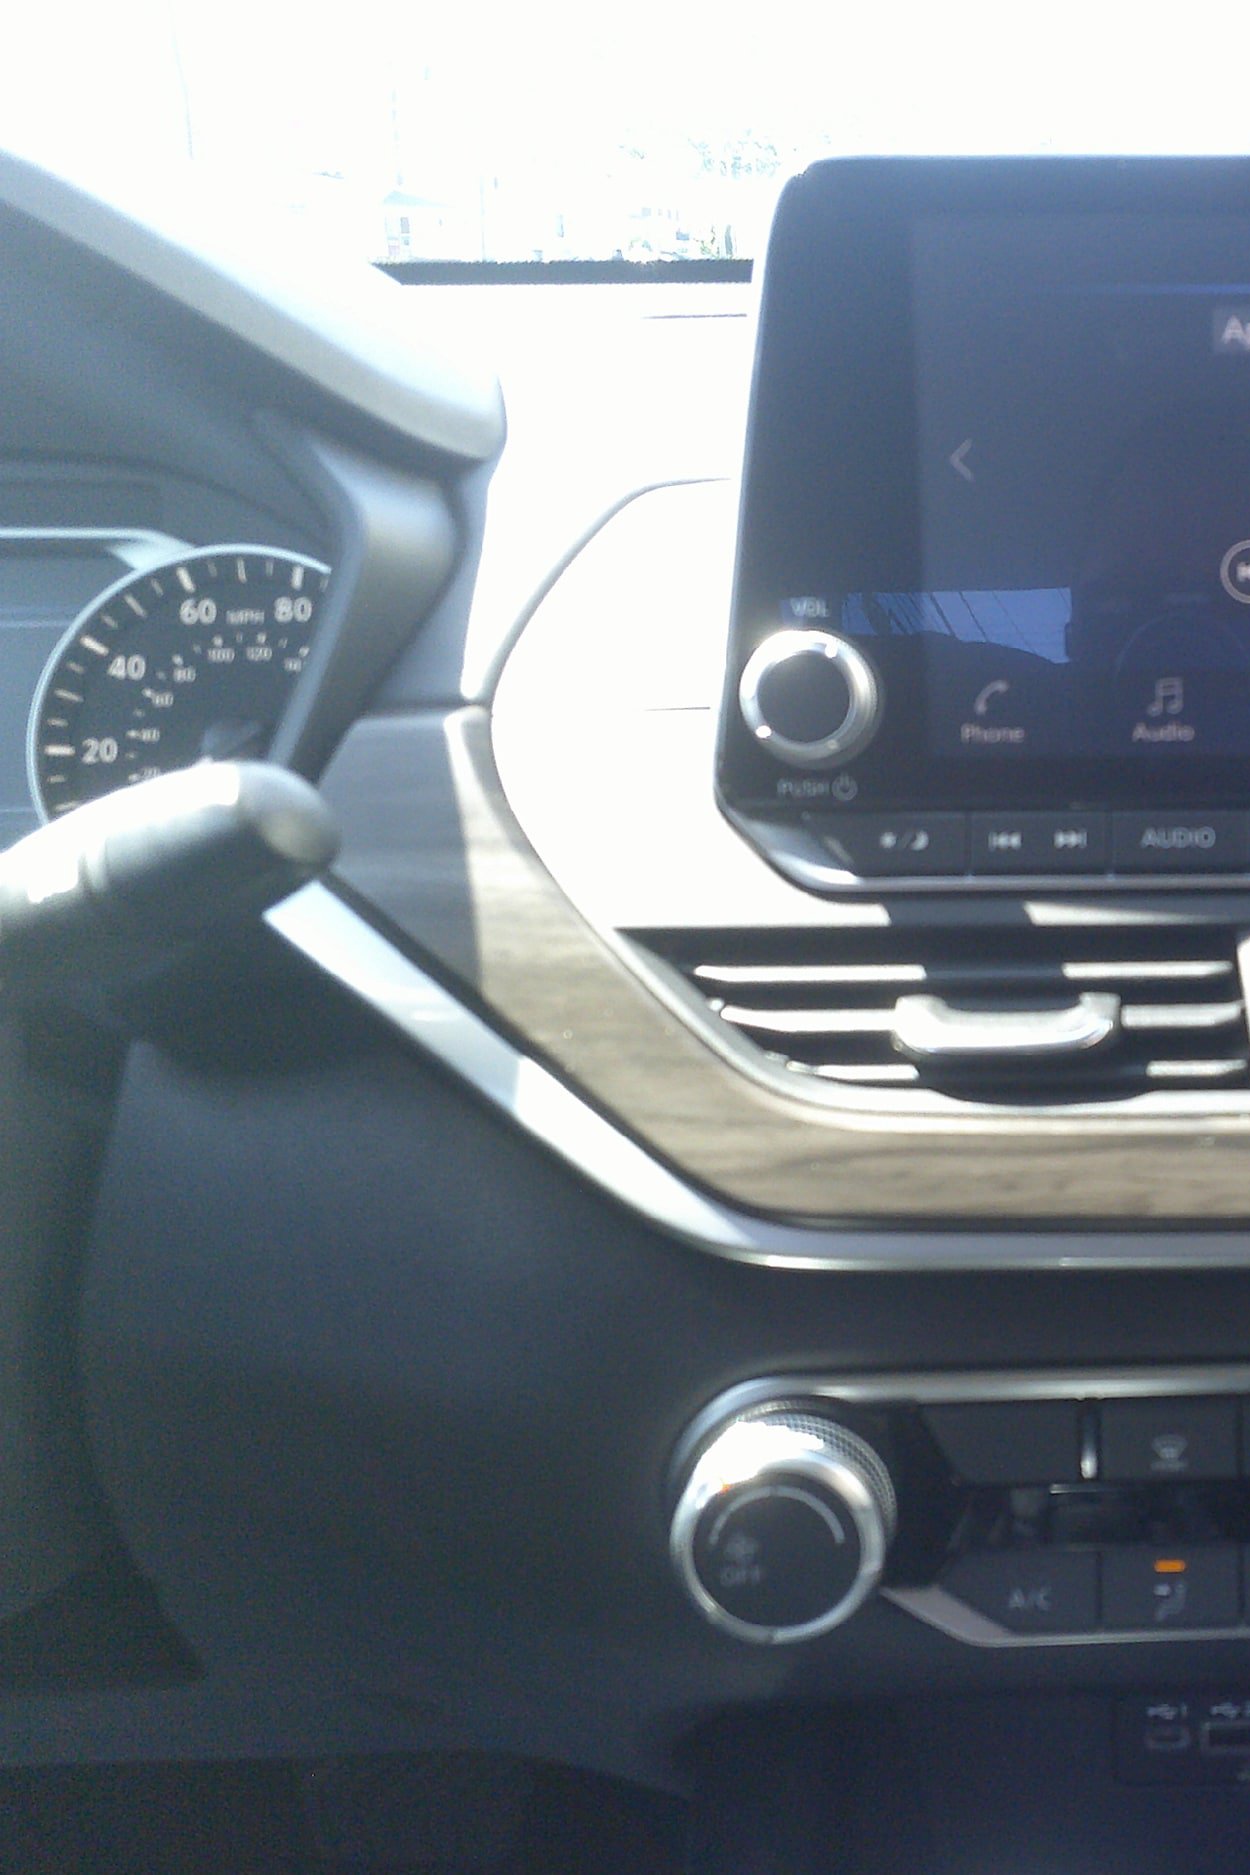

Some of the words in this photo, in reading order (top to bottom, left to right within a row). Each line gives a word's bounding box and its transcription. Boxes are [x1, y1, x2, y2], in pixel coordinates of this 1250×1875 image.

[180, 599, 216, 624] 60
[274, 597, 312, 622] 80
[108, 655, 146, 680] 40
[961, 723, 1025, 743] Phone
[1133, 722, 1194, 743] Audio
[81, 738, 118, 763] 20
[1141, 827, 1215, 848] AUDIO
